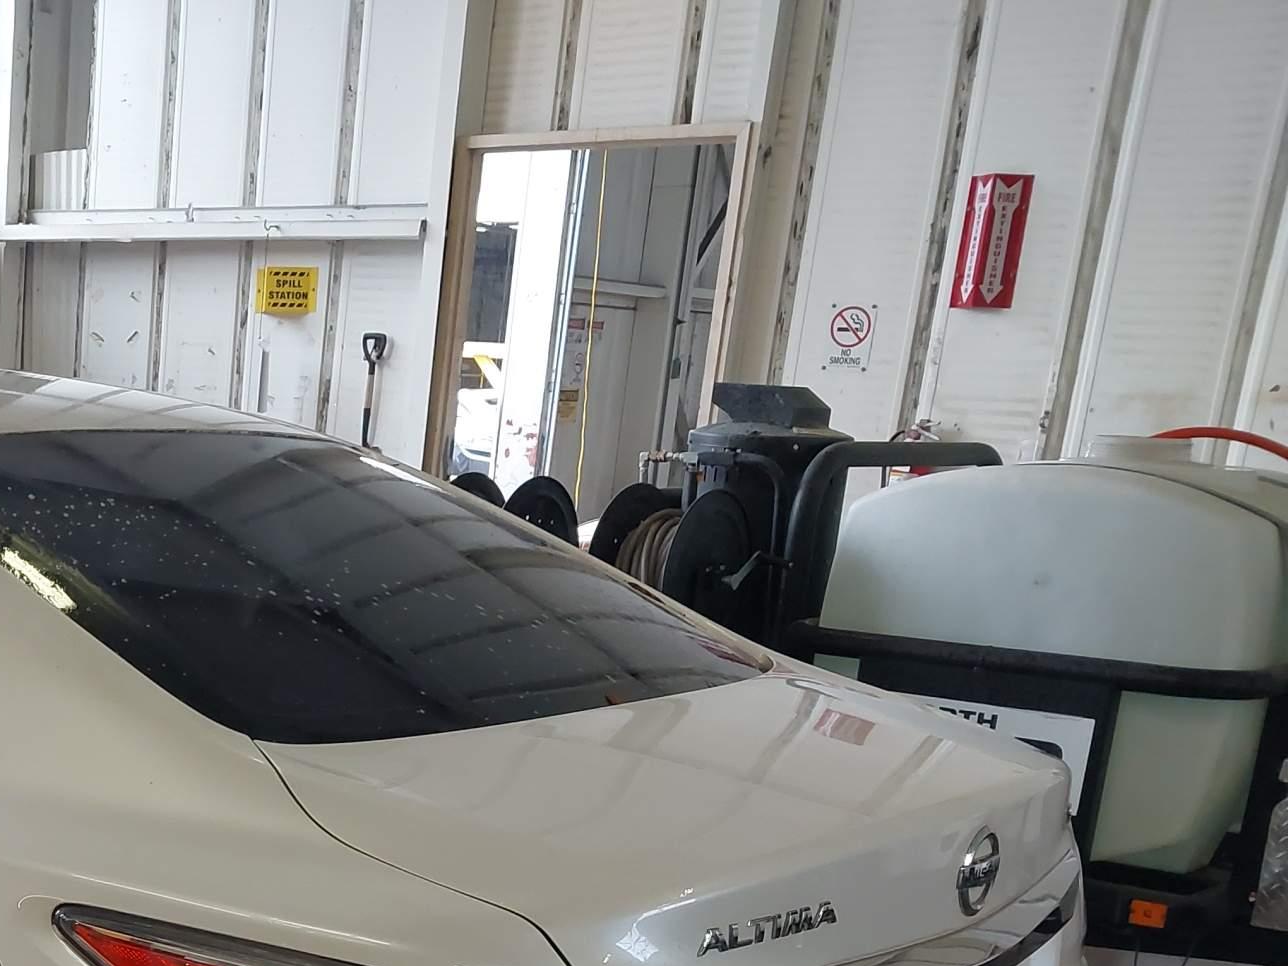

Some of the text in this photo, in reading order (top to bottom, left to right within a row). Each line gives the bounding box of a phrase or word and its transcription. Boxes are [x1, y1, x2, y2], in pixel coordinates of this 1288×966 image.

[997, 192, 1017, 203] FIRE
[275, 279, 303, 288] SPILL
[269, 291, 308, 299] STATION
[829, 356, 861, 365] SMOKING
[696, 900, 838, 957] ALTIMA
